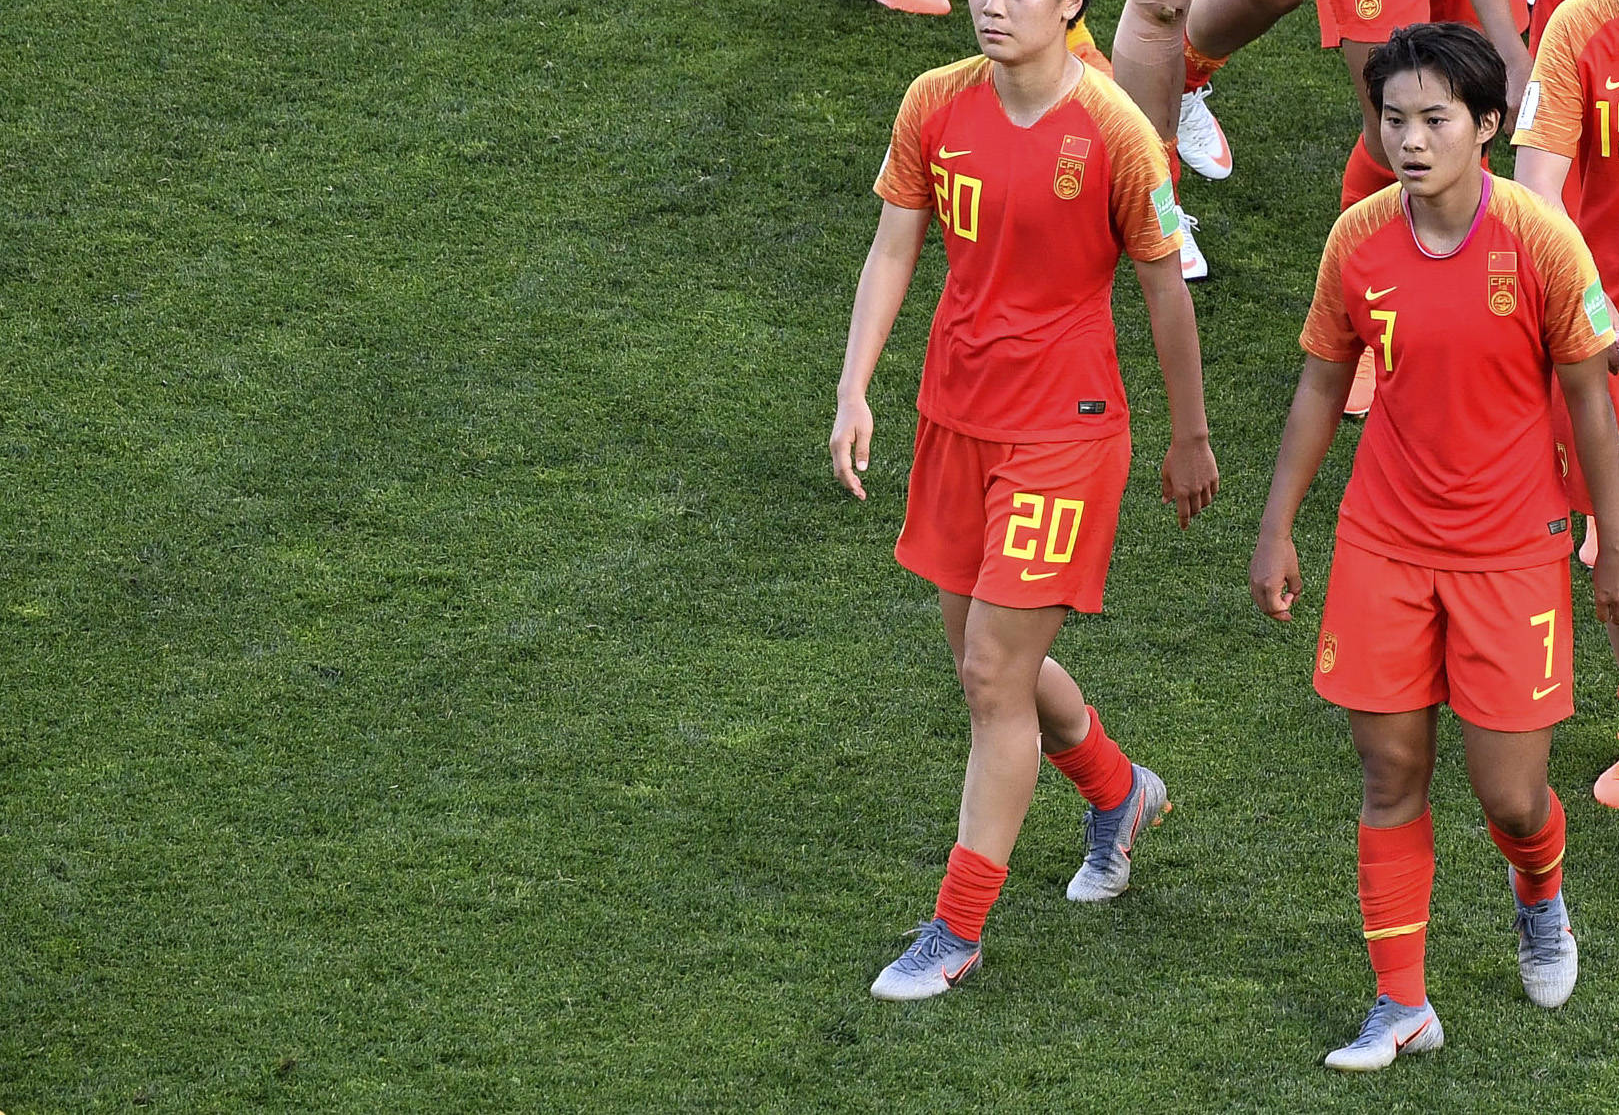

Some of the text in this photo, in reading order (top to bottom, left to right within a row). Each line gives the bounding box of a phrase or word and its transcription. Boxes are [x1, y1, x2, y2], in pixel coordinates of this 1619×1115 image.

[1059, 160, 1083, 172] CFA
[929, 161, 983, 243] 20
[1490, 277, 1514, 286] CFA
[1369, 309, 1398, 372] 7
[1002, 492, 1085, 563] 20
[1529, 608, 1556, 679] 7
